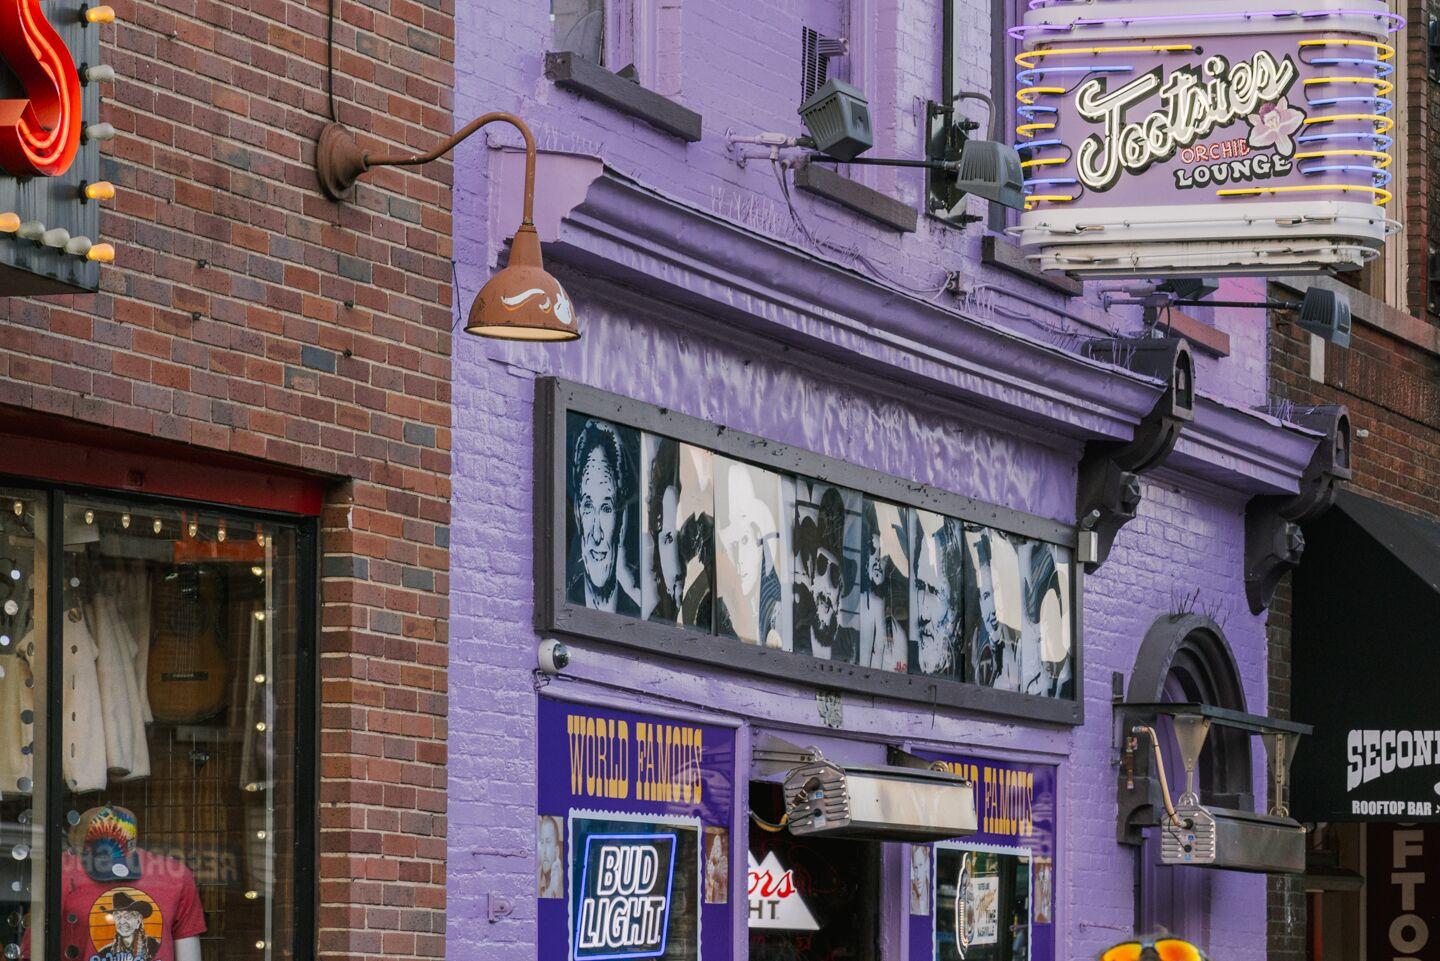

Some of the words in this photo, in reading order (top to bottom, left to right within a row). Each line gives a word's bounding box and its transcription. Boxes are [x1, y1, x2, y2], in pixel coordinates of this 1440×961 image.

[1075, 51, 1297, 189] Tootsies
[1176, 153, 1292, 189] LOUNGE
[1180, 137, 1250, 164] ORCHID
[567, 714, 629, 800] WORLD
[636, 722, 703, 805] FAMOUS
[983, 766, 1033, 837] FAMOUS
[1352, 800, 1405, 815] ROOFTOP
[1407, 801, 1432, 816] BAR
[596, 845, 659, 896] BUD
[748, 869, 796, 899] ors
[578, 896, 666, 948] LIGHT
